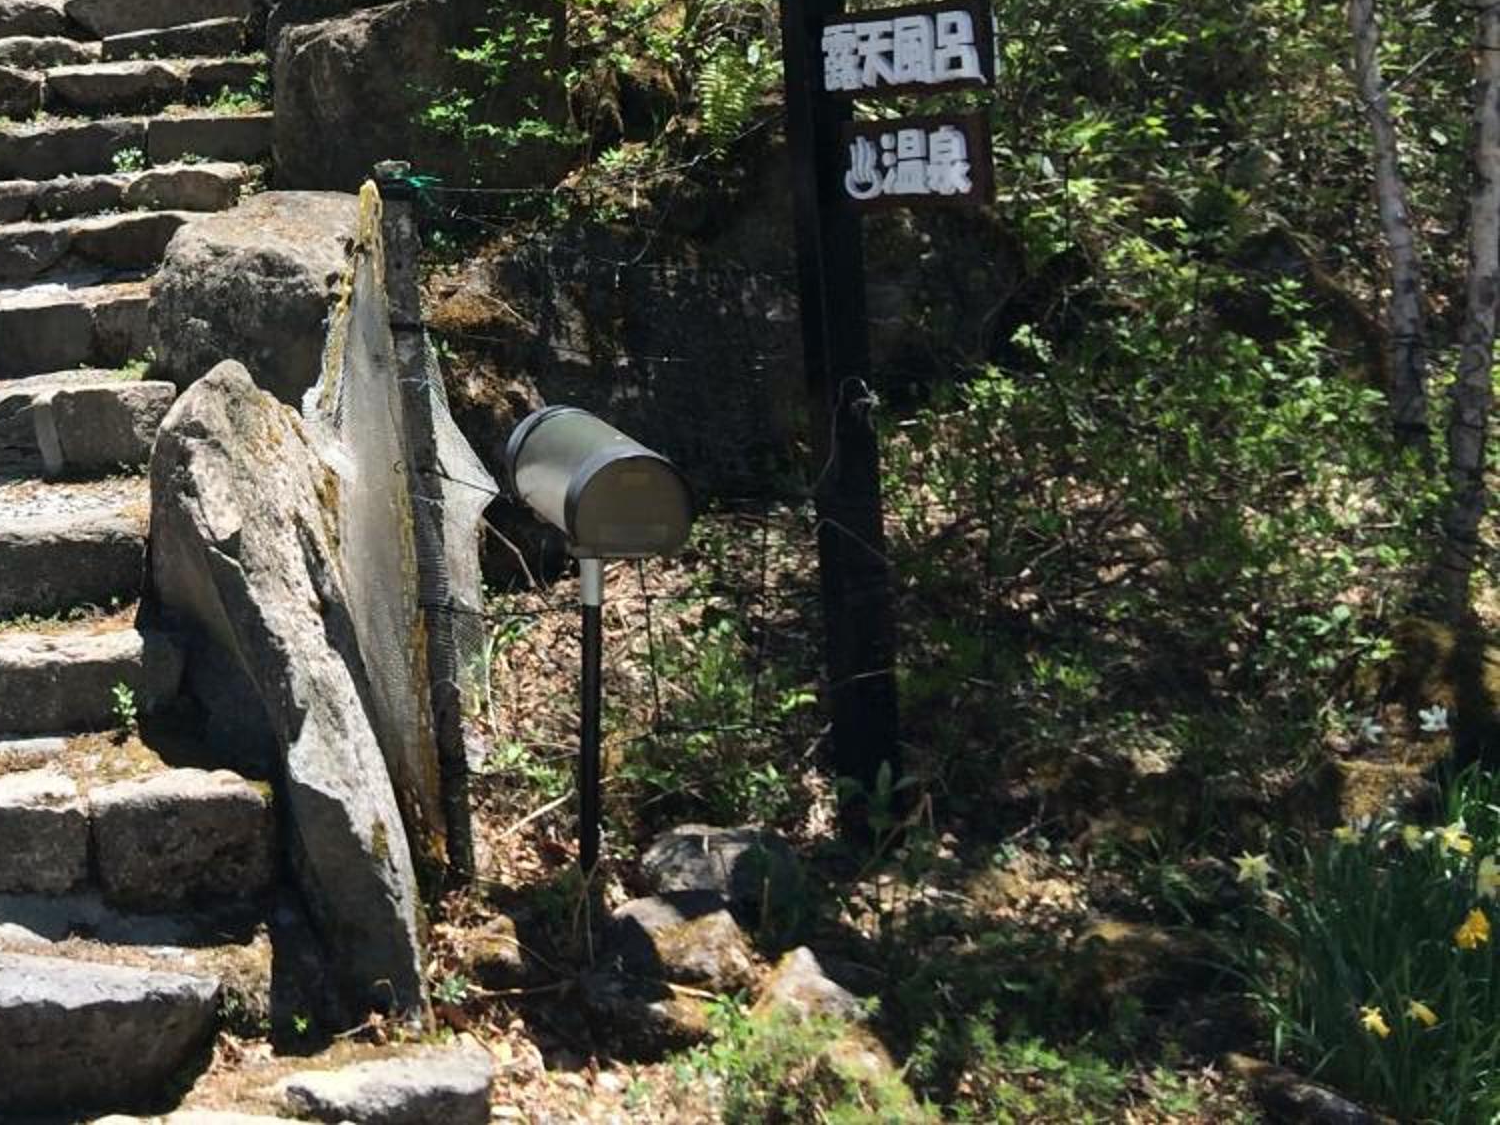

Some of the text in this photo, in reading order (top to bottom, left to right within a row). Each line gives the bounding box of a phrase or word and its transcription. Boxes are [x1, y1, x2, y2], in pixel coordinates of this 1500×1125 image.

[822, 10, 986, 91] 露天風呂
[880, 125, 972, 195] 温泉
